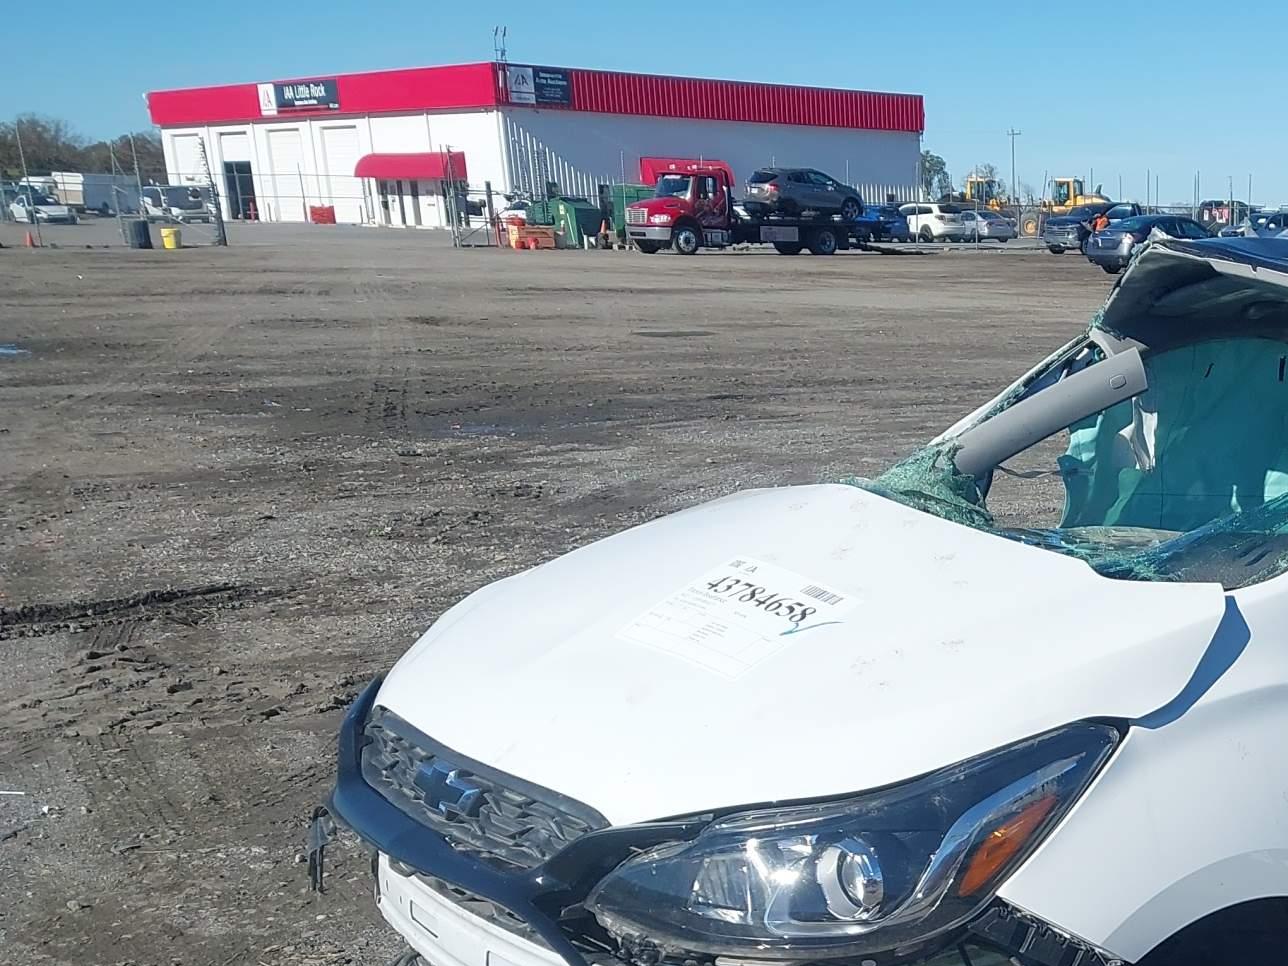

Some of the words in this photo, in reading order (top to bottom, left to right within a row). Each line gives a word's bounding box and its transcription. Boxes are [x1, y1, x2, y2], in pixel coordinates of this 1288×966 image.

[283, 85, 294, 99] IAA
[294, 84, 310, 98] Little
[310, 83, 326, 97] Rock
[707, 576, 816, 622] 43784658
